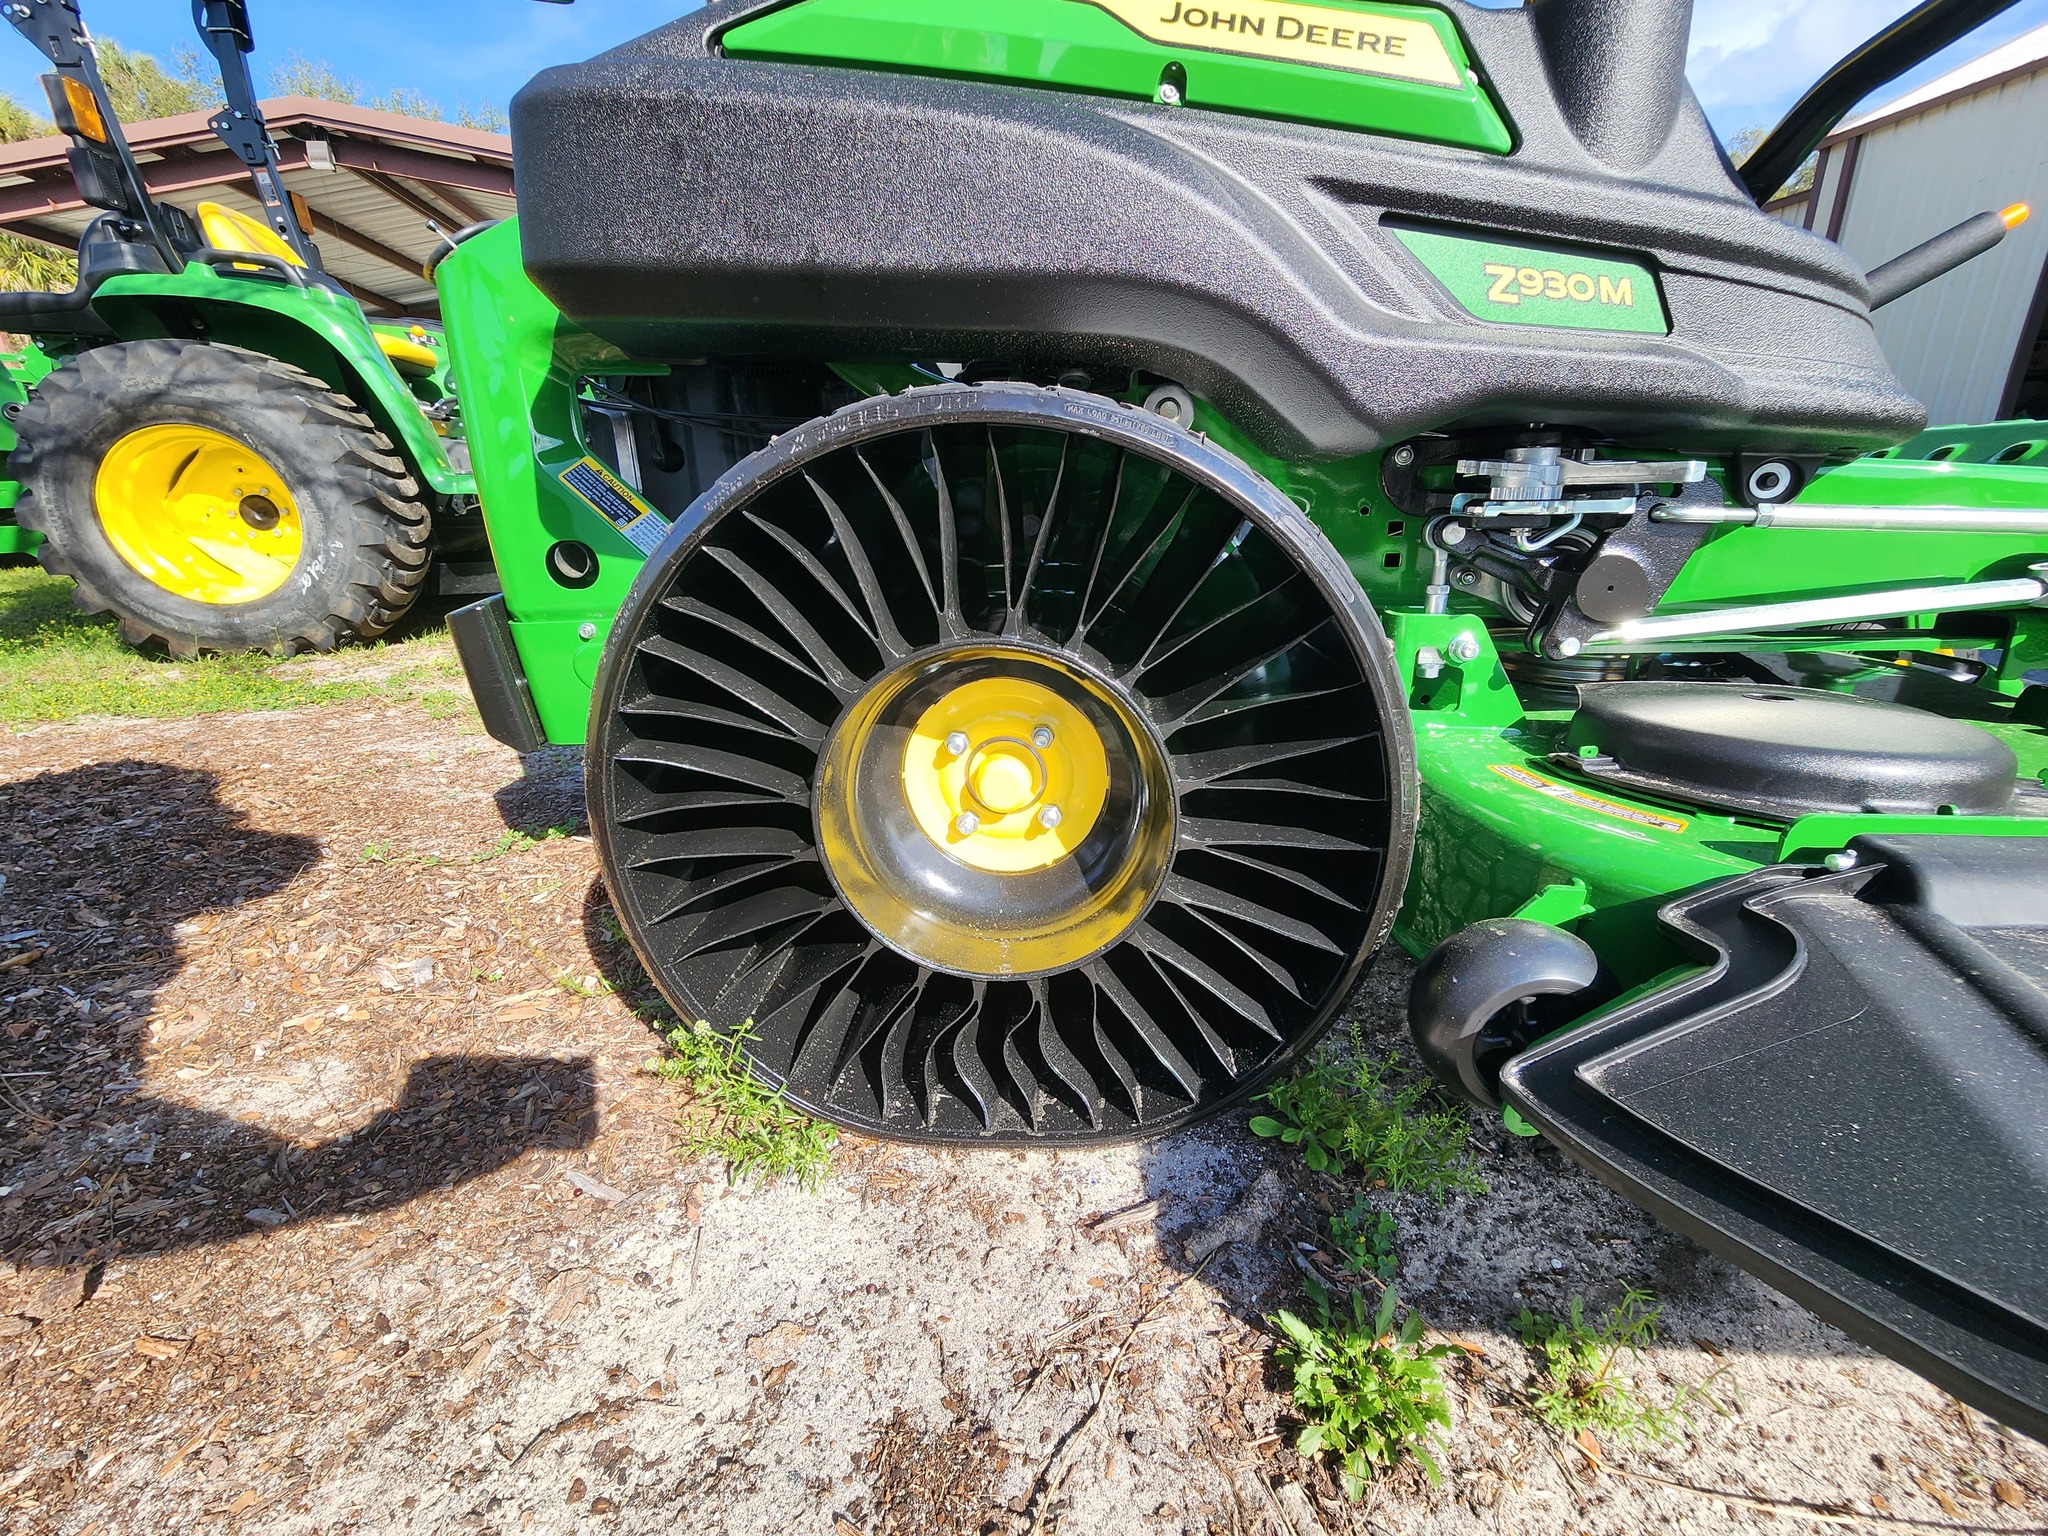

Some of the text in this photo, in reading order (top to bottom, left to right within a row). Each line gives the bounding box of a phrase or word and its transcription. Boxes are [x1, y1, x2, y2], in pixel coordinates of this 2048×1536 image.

[1160, 1, 1407, 57] JOHN DEERE
[1483, 262, 1633, 307] Z930M
[602, 474, 635, 502] CAUTION
